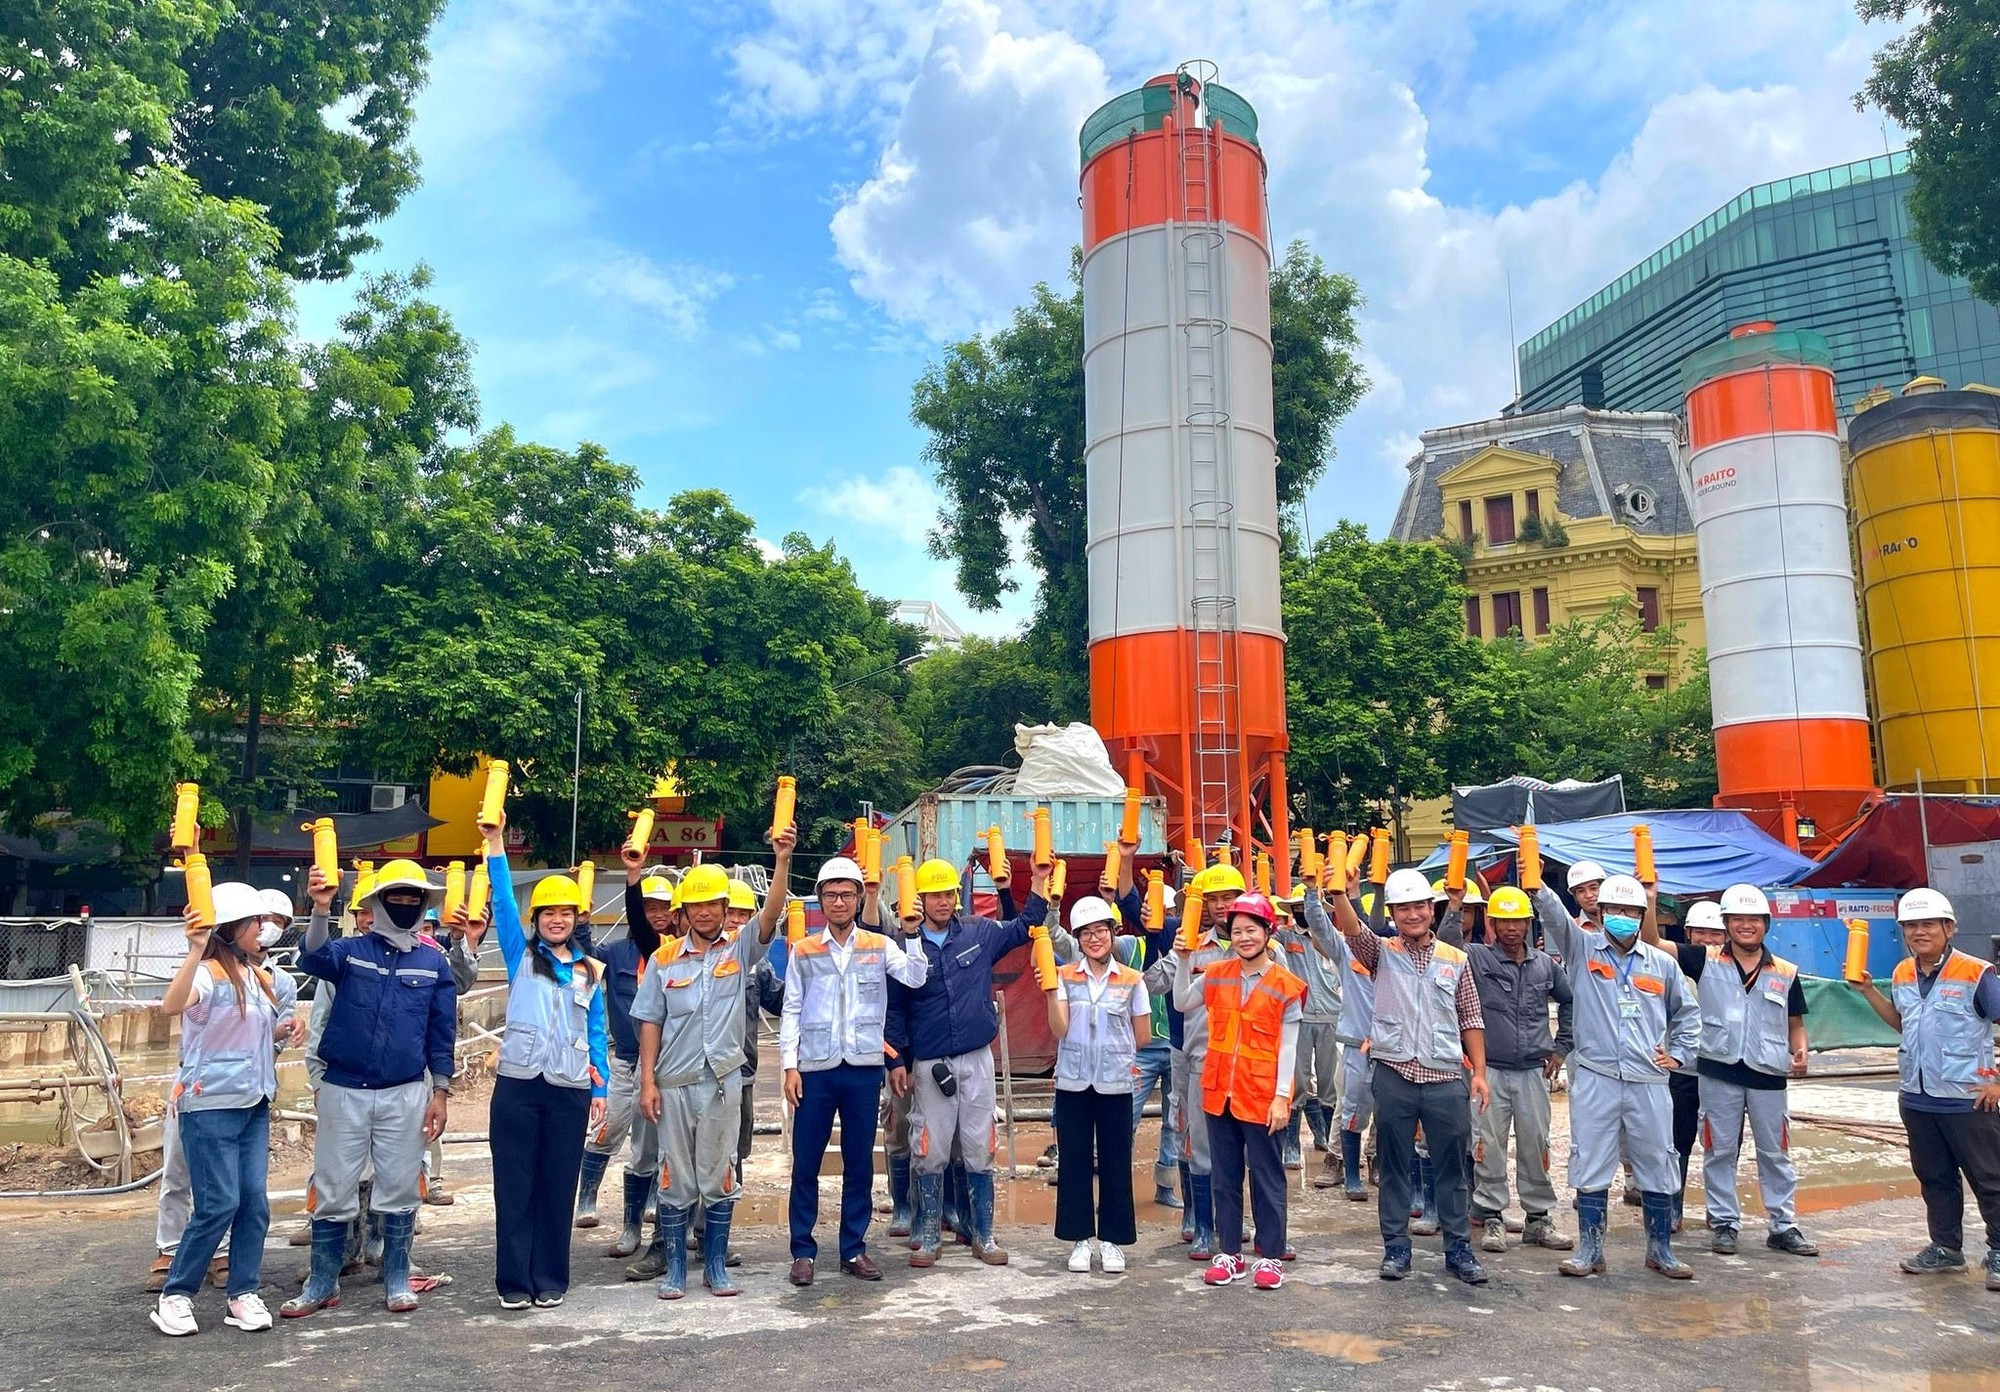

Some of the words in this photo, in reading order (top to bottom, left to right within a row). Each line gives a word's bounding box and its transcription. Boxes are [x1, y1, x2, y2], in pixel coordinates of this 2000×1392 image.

[1704, 467, 1736, 485] RAITO
[680, 826, 707, 842] 86
[1616, 886, 1634, 894] FRU
